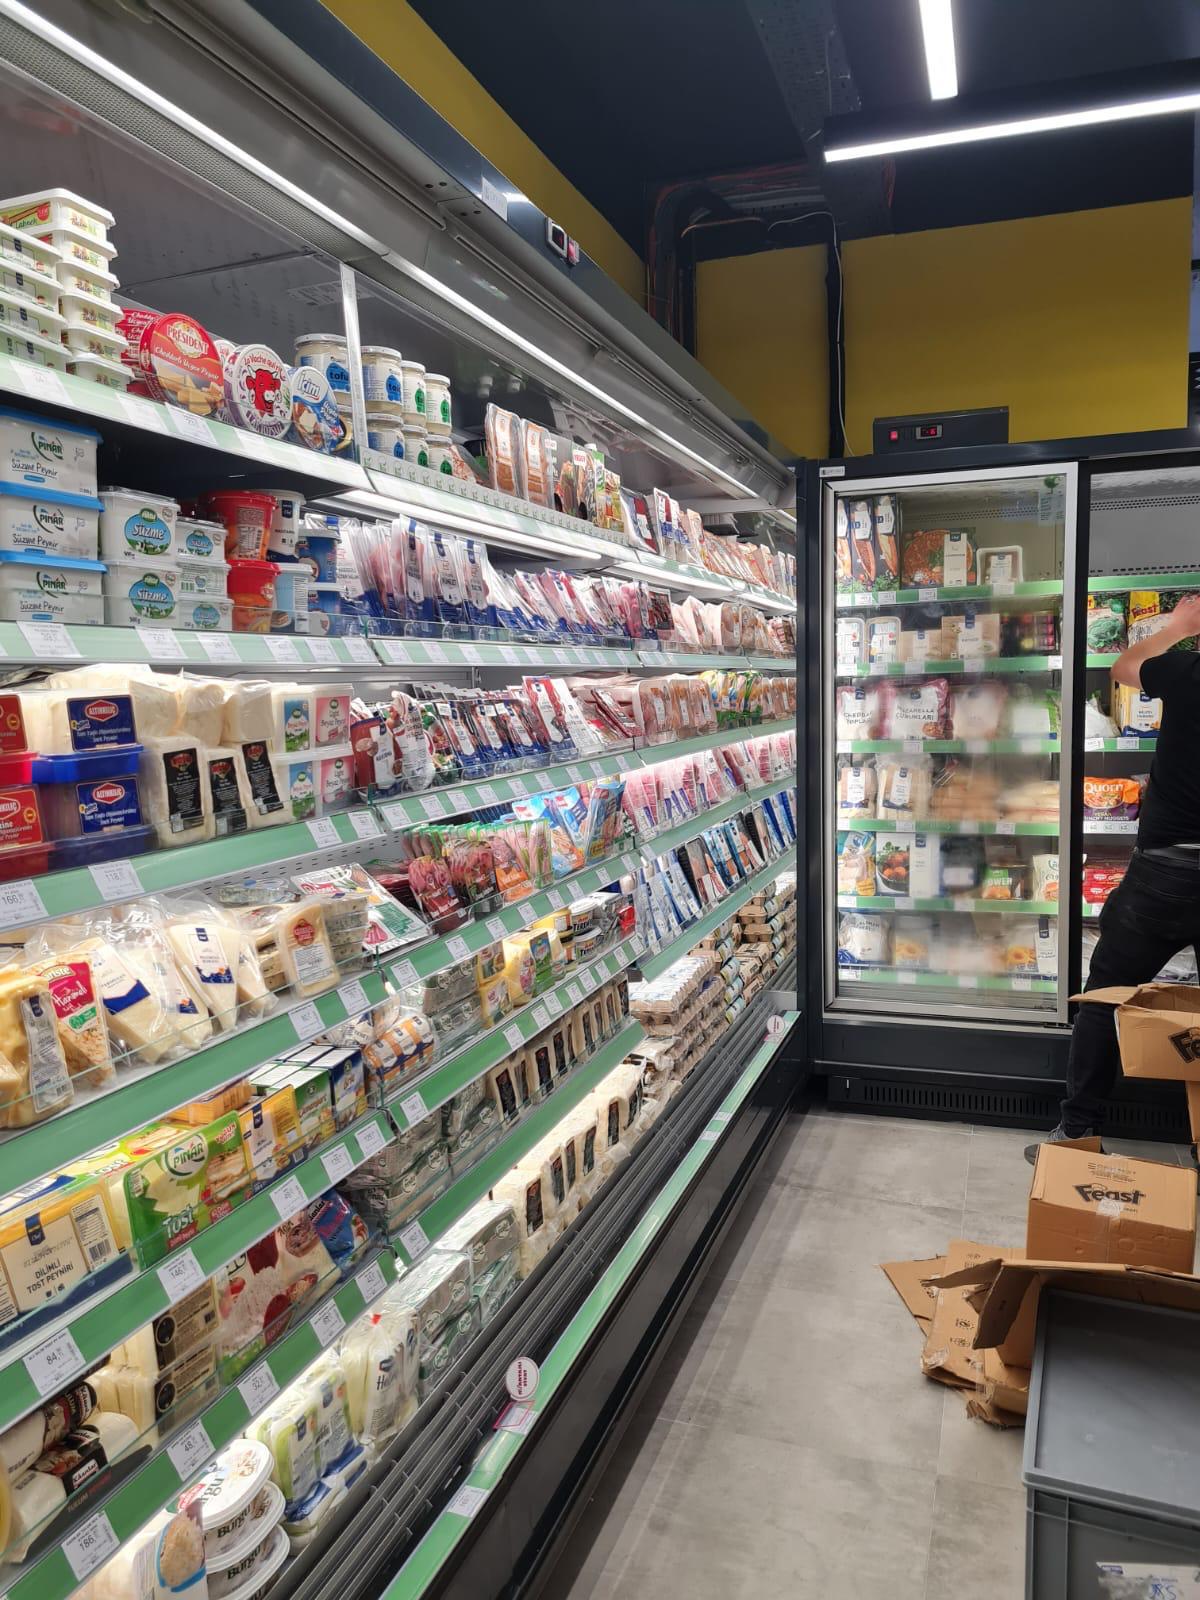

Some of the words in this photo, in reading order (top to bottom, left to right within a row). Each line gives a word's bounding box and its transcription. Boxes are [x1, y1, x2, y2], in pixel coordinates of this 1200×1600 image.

[167, 324, 209, 355] PRÉSIDENT
[132, 523, 167, 540] Süzme
[137, 588, 168, 602] Süzme
[1084, 782, 1124, 794] Quorn
[173, 1142, 204, 1169] PINAR
[1072, 1182, 1146, 1206] Feast
[26, 1278, 45, 1294] TOST
[46, 1263, 74, 1282] PEYNİRİ
[35, 1258, 62, 1279] DİLİMLİ
